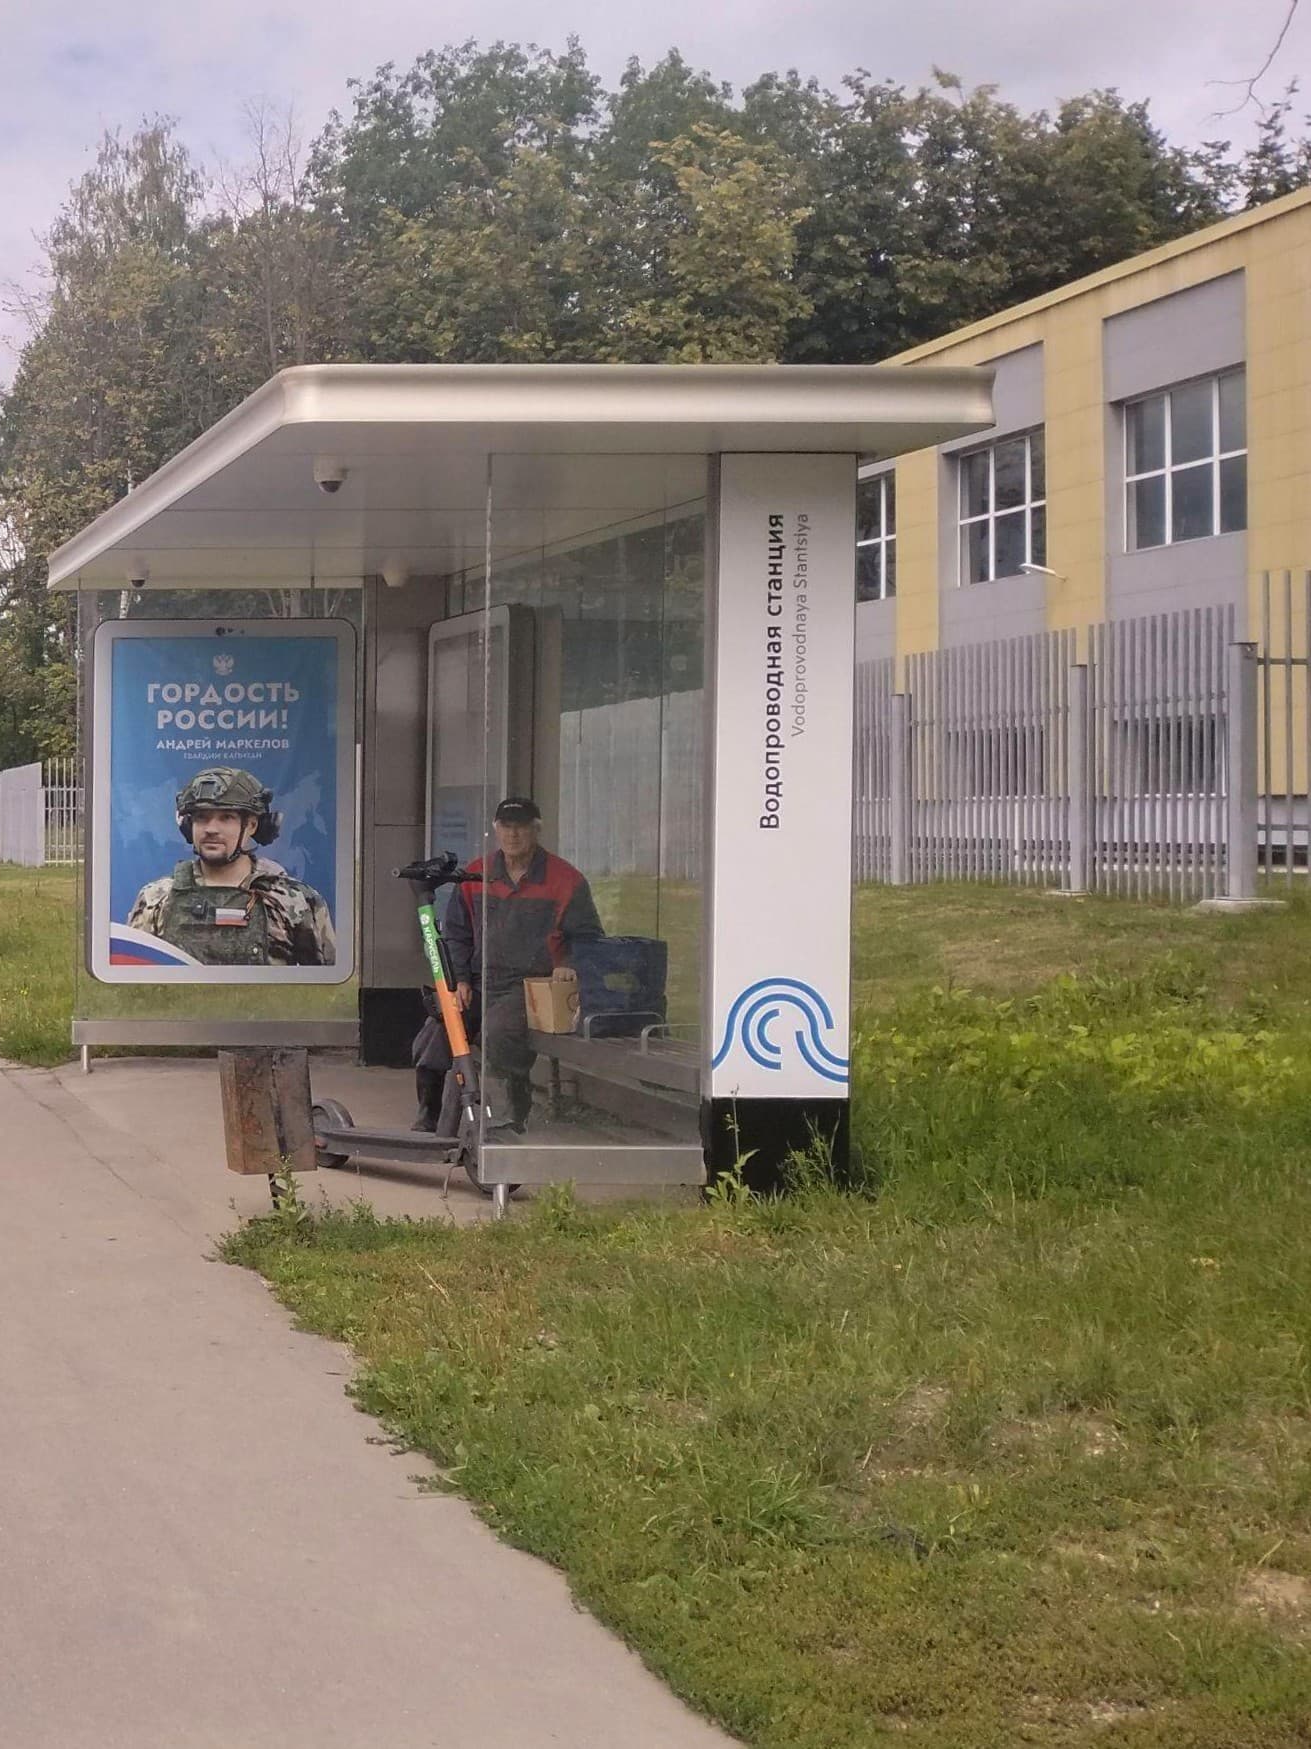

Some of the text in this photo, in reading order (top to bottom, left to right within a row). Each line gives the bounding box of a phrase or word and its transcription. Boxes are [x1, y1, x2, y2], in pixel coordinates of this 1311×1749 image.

[791, 513, 811, 737] Vodoprovodnaya Stantsiya
[760, 514, 786, 829] Водопроводная станция
[147, 682, 300, 706] ГОРДОСТЬ
[157, 709, 288, 730] РОССИИ!
[156, 737, 290, 750] АНДРЕЙ МАРКЕЛОВ
